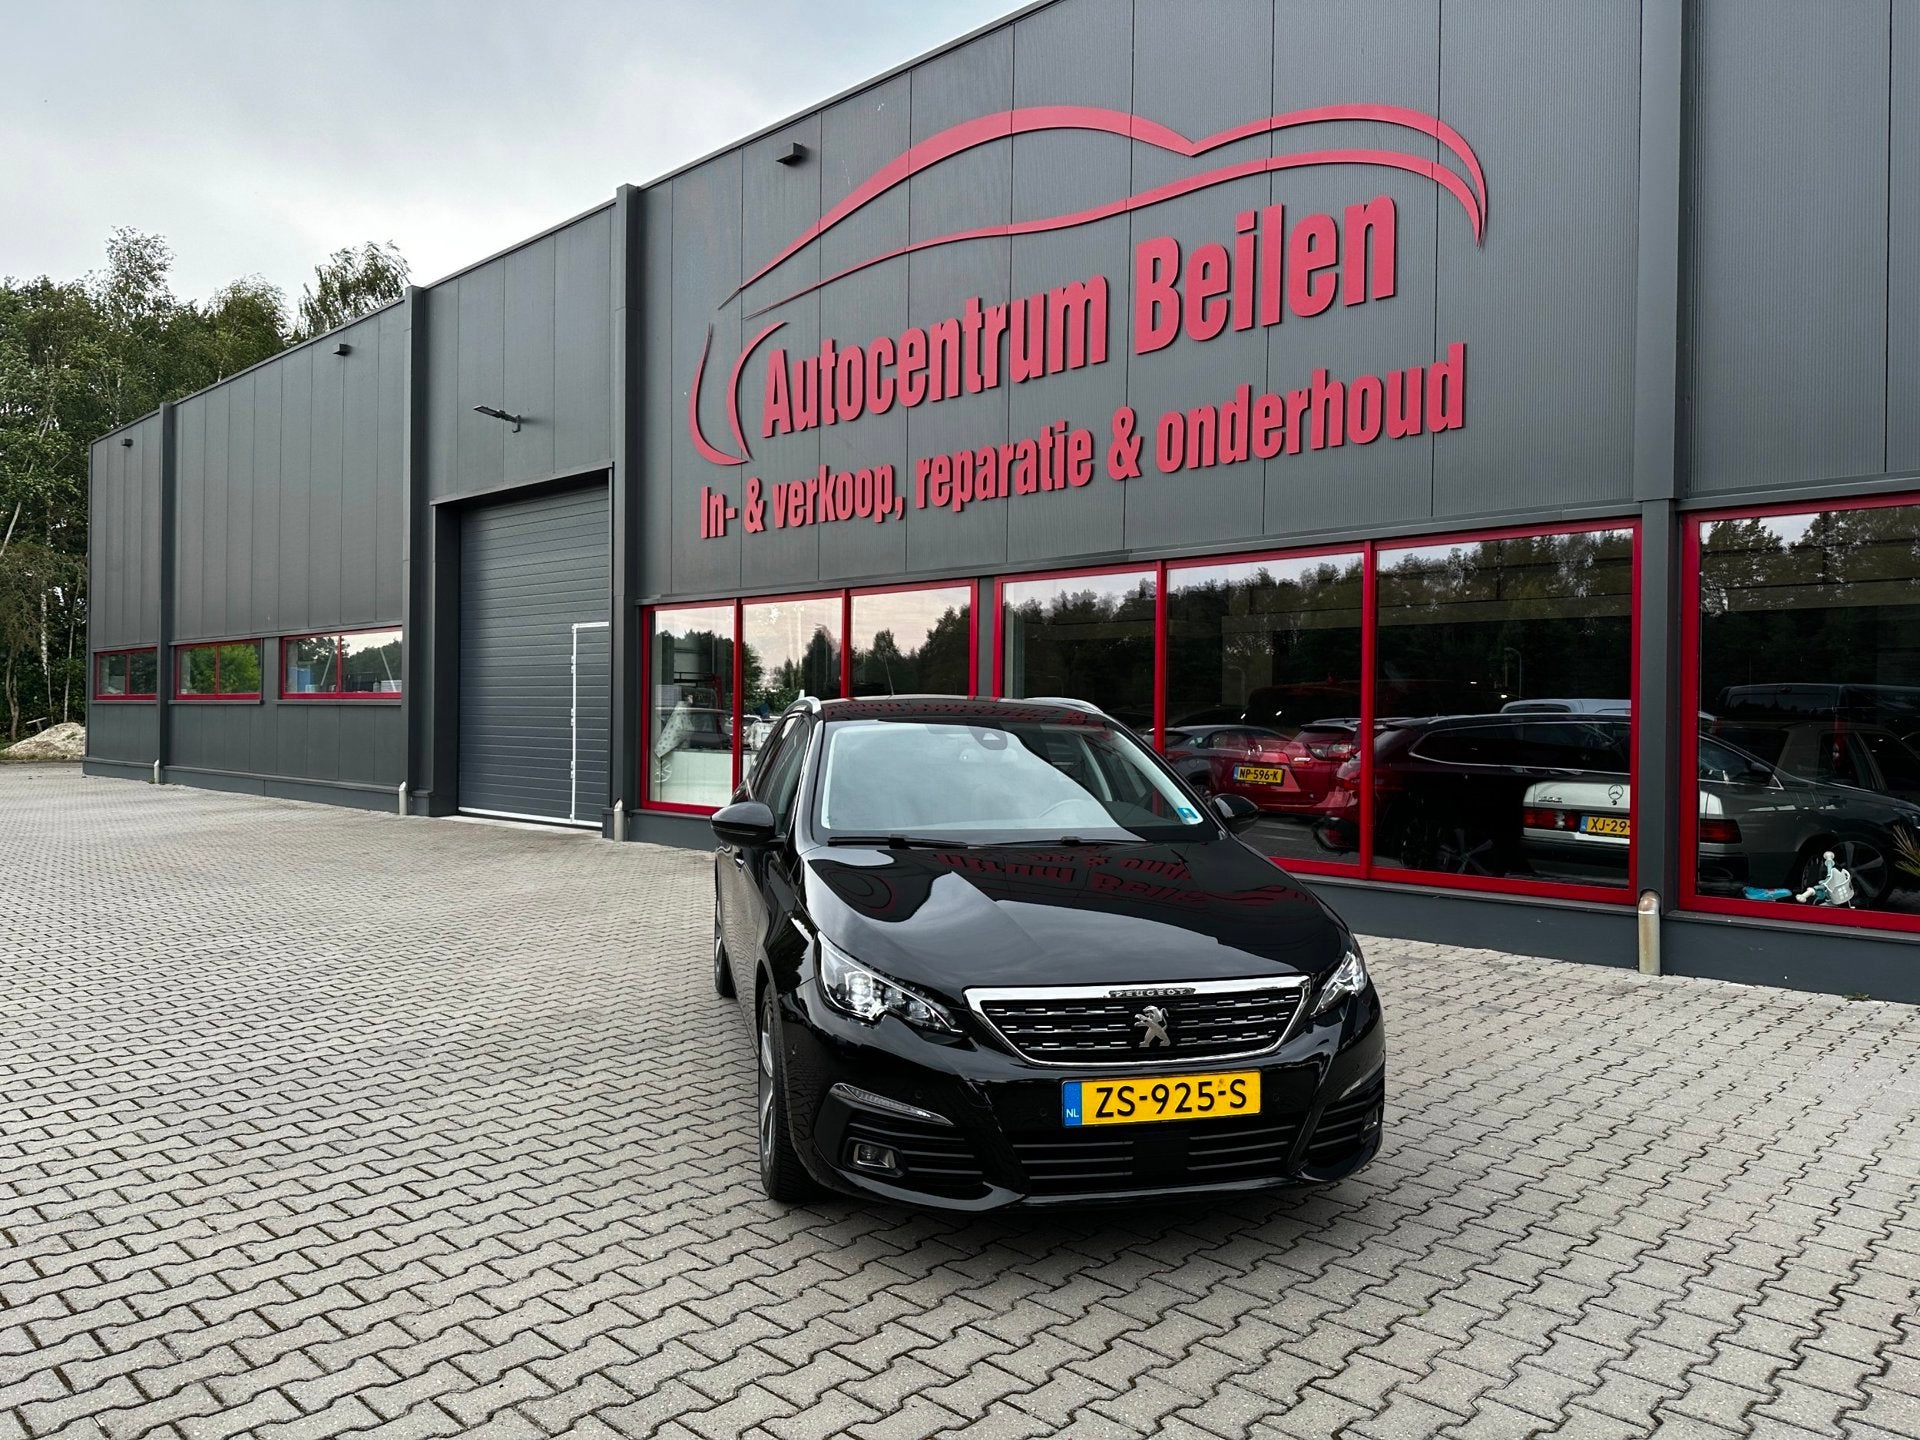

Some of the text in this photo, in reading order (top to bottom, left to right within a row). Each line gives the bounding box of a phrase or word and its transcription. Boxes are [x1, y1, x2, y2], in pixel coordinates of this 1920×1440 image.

[763, 196, 1396, 438] Autocentrum Beilen
[701, 343, 1465, 538] In- & verkoop, reparatie & onderhoud
[1239, 768, 1279, 781] NP-596-K
[1115, 988, 1186, 997] PEUGEOT
[1095, 1078, 1247, 1118] ZS-925-S
[1066, 1108, 1079, 1118] NL
